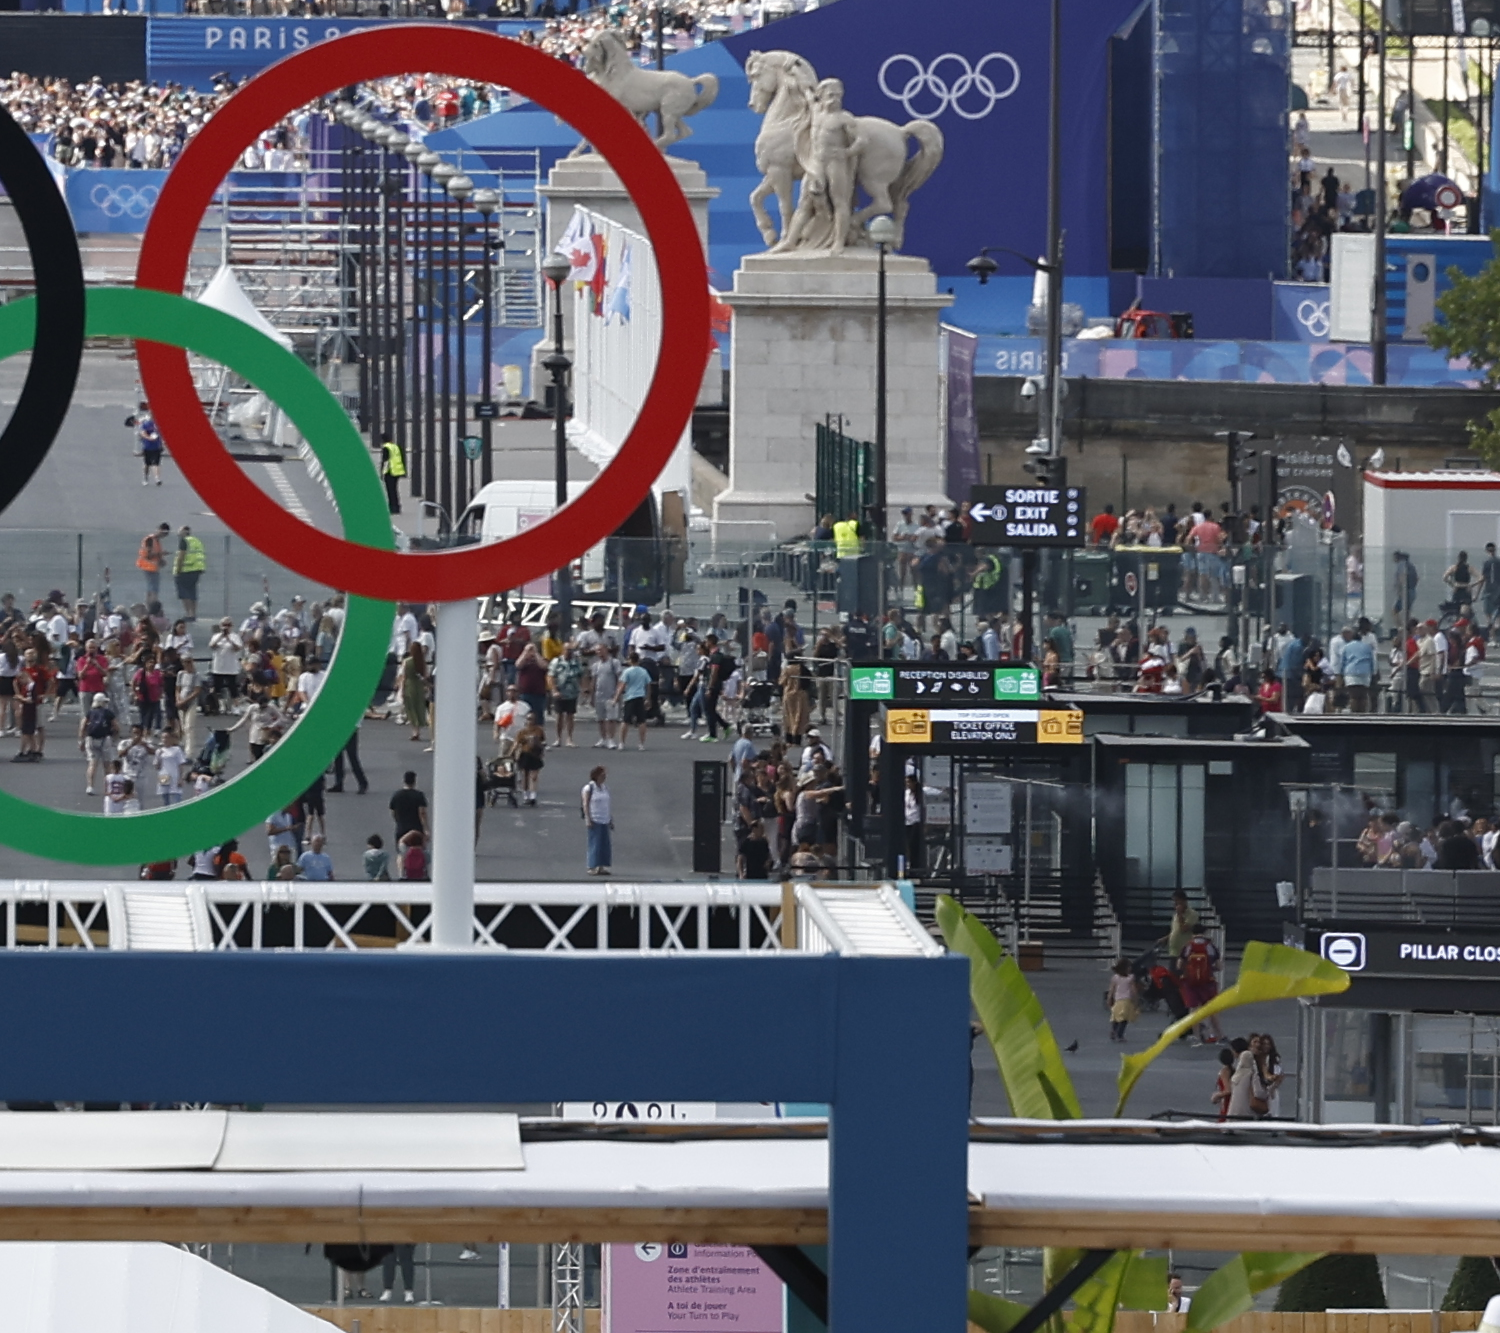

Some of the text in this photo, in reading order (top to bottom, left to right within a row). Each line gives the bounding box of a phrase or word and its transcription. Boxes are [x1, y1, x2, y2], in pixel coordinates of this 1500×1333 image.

[1005, 489, 1060, 504] SORTIE
[1015, 506, 1049, 520] EXIT
[1006, 523, 1058, 536] SALIDA
[899, 671, 990, 680] RECEPTION DISABLED
[953, 722, 1015, 730] TICKET OFFICE
[951, 731, 1017, 740] ELEVATOR ONLY
[1400, 944, 1458, 960] PILLAR
[694, 1249, 745, 1258] Information
[668, 1266, 690, 1274] Zone
[668, 1275, 682, 1284] des
[667, 1285, 757, 1295] Athlete Training Area
[676, 1302, 688, 1310] toi
[691, 1302, 702, 1310] de
[704, 1302, 727, 1311] jouer
[668, 1312, 740, 1322] Your Turn to Play
